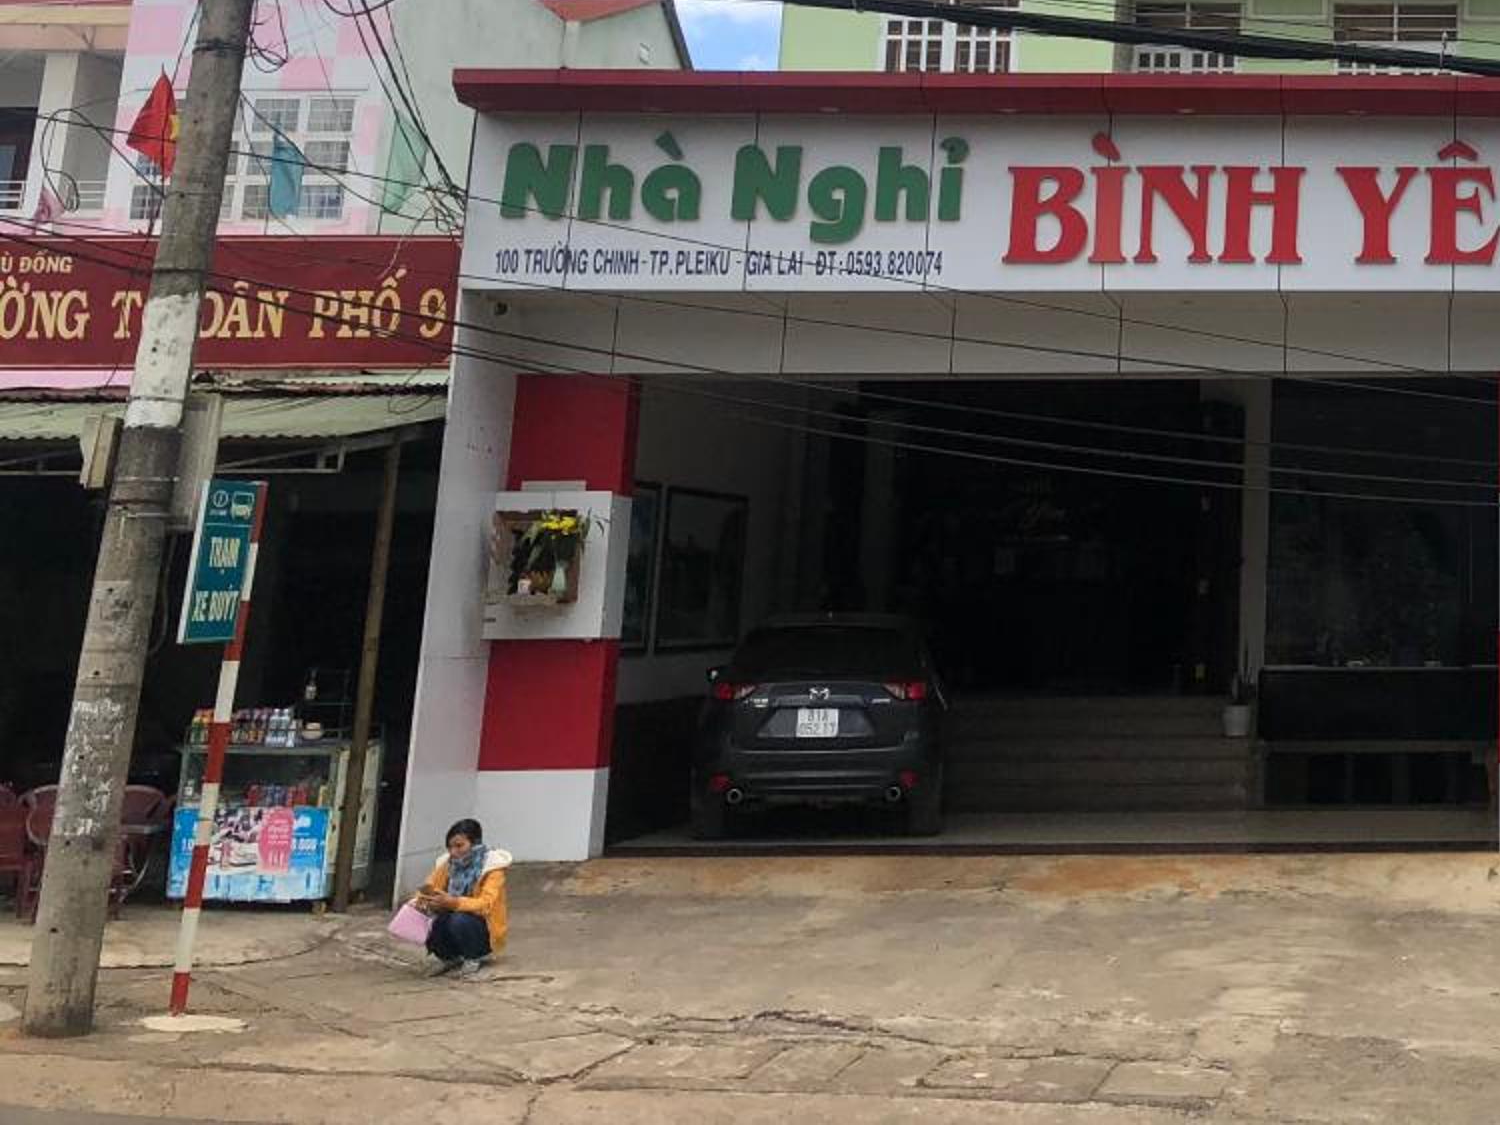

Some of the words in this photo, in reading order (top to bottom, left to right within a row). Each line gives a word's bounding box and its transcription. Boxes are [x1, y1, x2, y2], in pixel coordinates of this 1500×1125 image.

[500, 130, 701, 221] Nhà
[730, 136, 970, 244] Nghỉ
[1002, 131, 1306, 265] BÌNH
[495, 248, 519, 274] 100
[593, 248, 639, 274] CHINH
[748, 250, 772, 275] GIA
[777, 250, 803, 275] LAI
[0, 275, 91, 340] ỜNG
[308, 266, 407, 339] PHỐ
[419, 288, 447, 339] 9
[192, 590, 209, 622] XE
